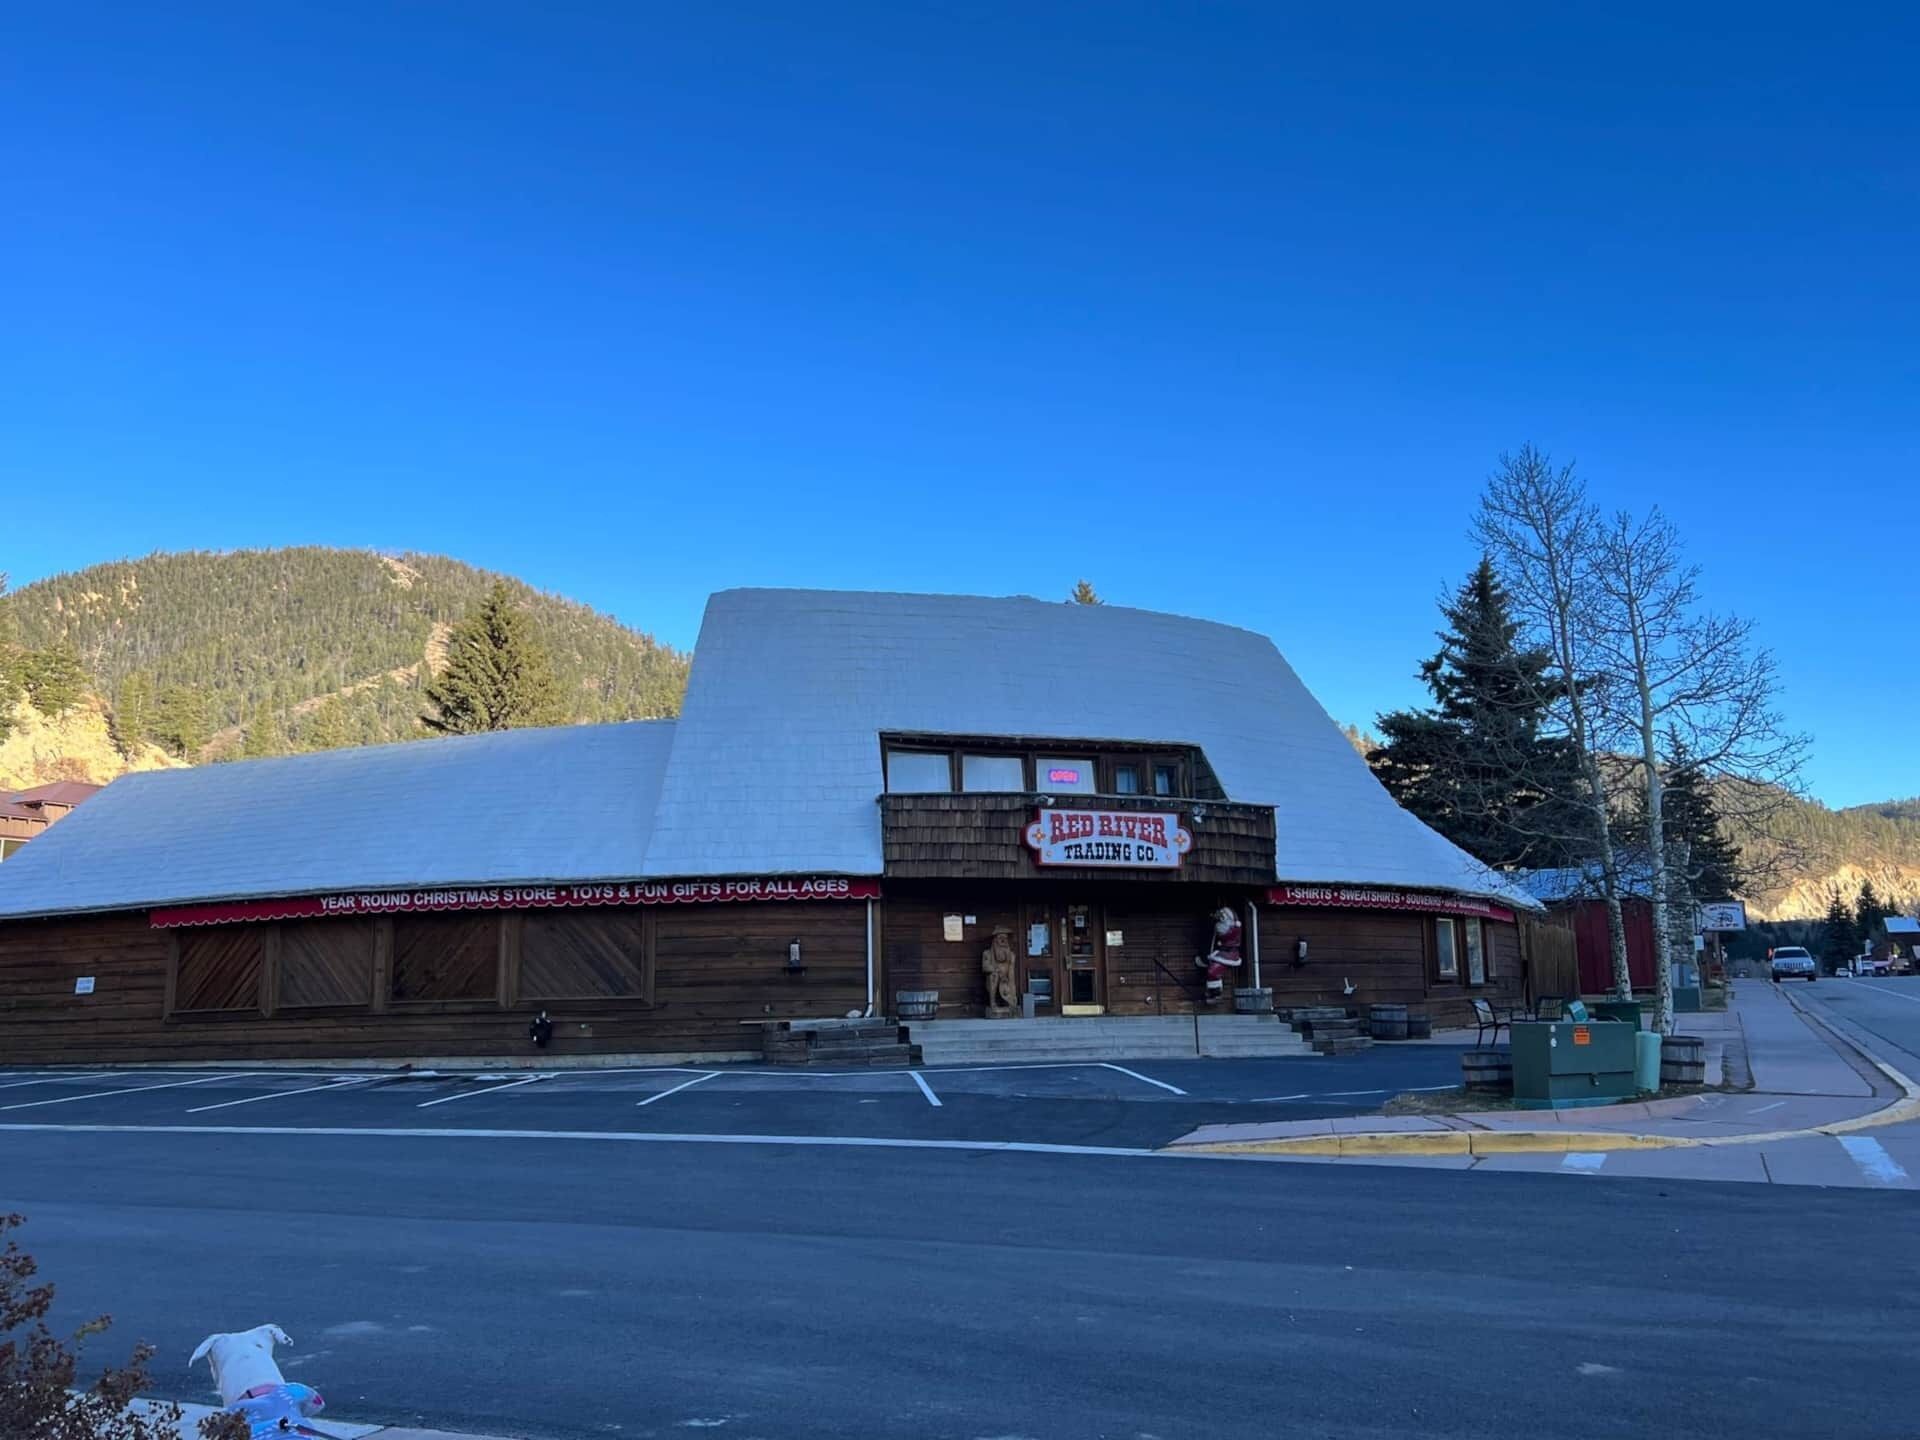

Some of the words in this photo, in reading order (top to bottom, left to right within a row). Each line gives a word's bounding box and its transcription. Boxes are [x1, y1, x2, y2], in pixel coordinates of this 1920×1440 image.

[1050, 770, 1078, 782] OPEN
[1050, 813, 1094, 845] RED
[1099, 815, 1168, 849] RIVER
[1064, 842, 1132, 861] TRADING
[1136, 845, 1159, 861] CO.
[320, 895, 355, 910] YEAR
[359, 892, 410, 908] 'ROUND
[413, 888, 500, 906] CHRISTMAS
[503, 886, 557, 902] STORE
[572, 885, 614, 899] TOYS
[618, 884, 630, 898] &
[634, 883, 668, 898] FUN
[672, 882, 721, 896] GIFTS
[726, 881, 760, 894] FOR
[765, 880, 798, 893] ALL
[801, 878, 849, 892] AGES
[1285, 887, 1332, 900] T-SHIRTS
[1339, 889, 1400, 904] SWEATSHIRTS
